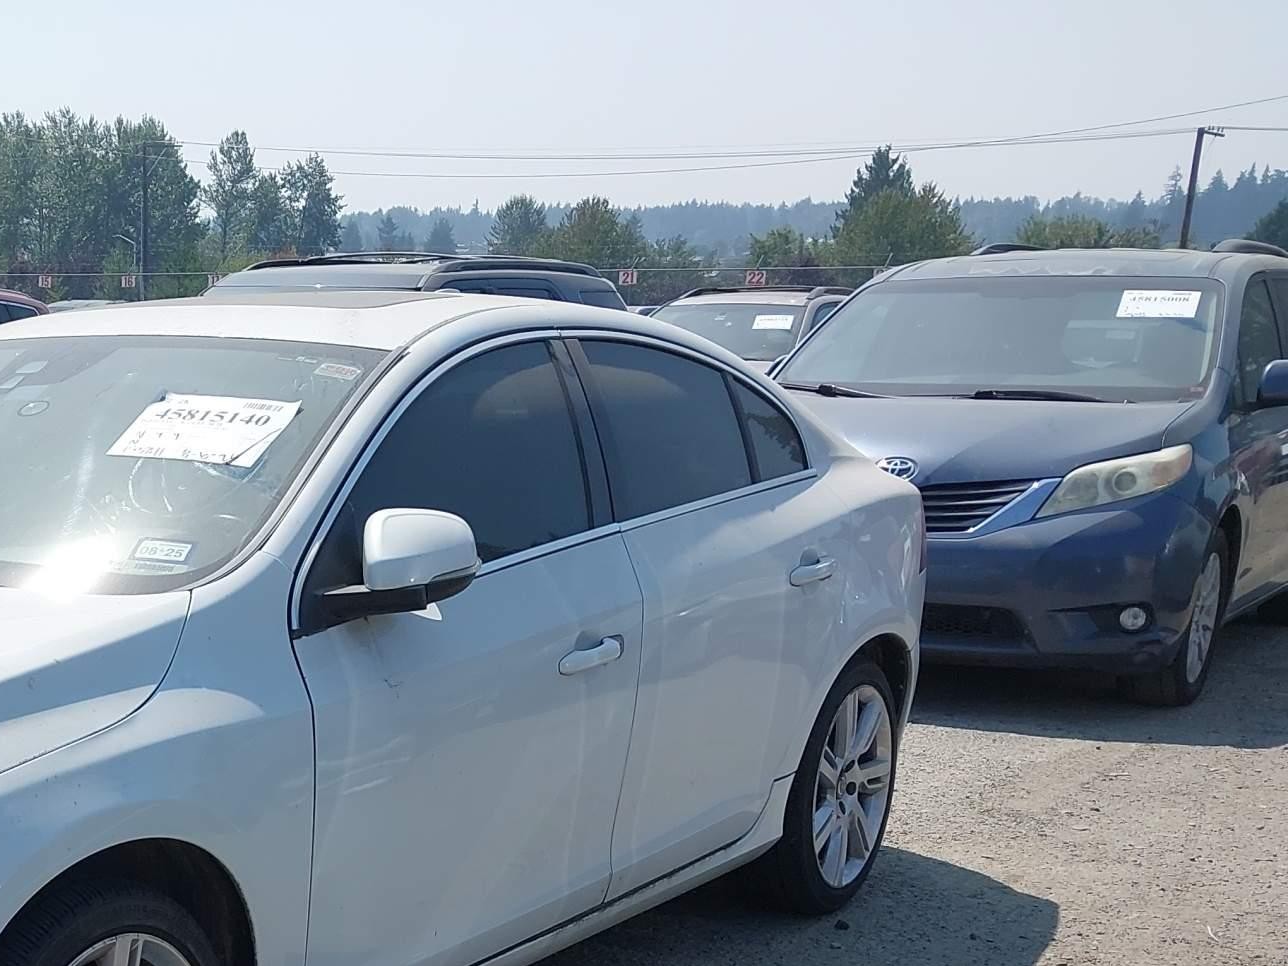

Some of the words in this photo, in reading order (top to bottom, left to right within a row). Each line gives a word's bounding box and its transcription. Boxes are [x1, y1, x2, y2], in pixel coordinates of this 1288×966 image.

[41, 275, 50, 287] 15
[124, 276, 134, 287] 16
[622, 271, 634, 284] 21
[747, 271, 765, 285] 22
[155, 408, 272, 427] 45815140
